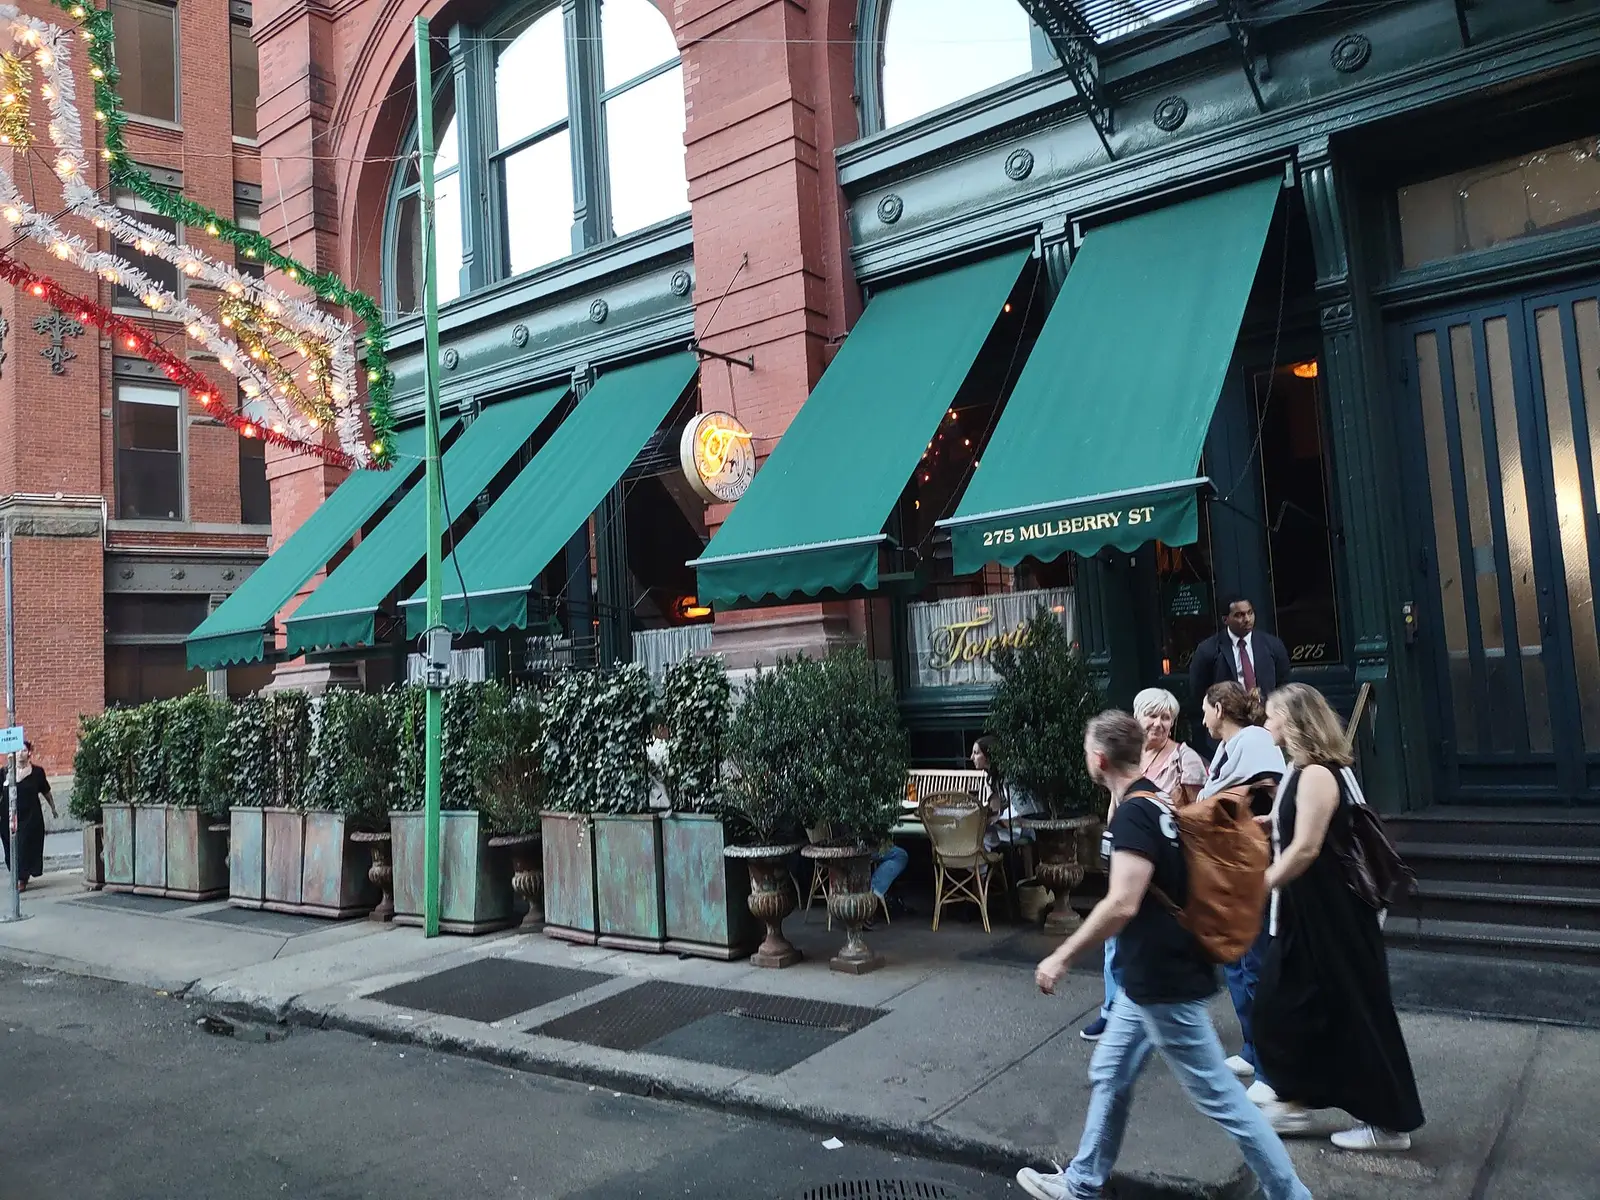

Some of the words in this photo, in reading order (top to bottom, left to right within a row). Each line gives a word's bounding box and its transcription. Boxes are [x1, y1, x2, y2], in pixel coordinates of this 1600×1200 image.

[983, 528, 1015, 546] 275
[1019, 511, 1122, 541] MULBERRY
[1127, 506, 1155, 525] ST
[1290, 642, 1326, 662] 275
